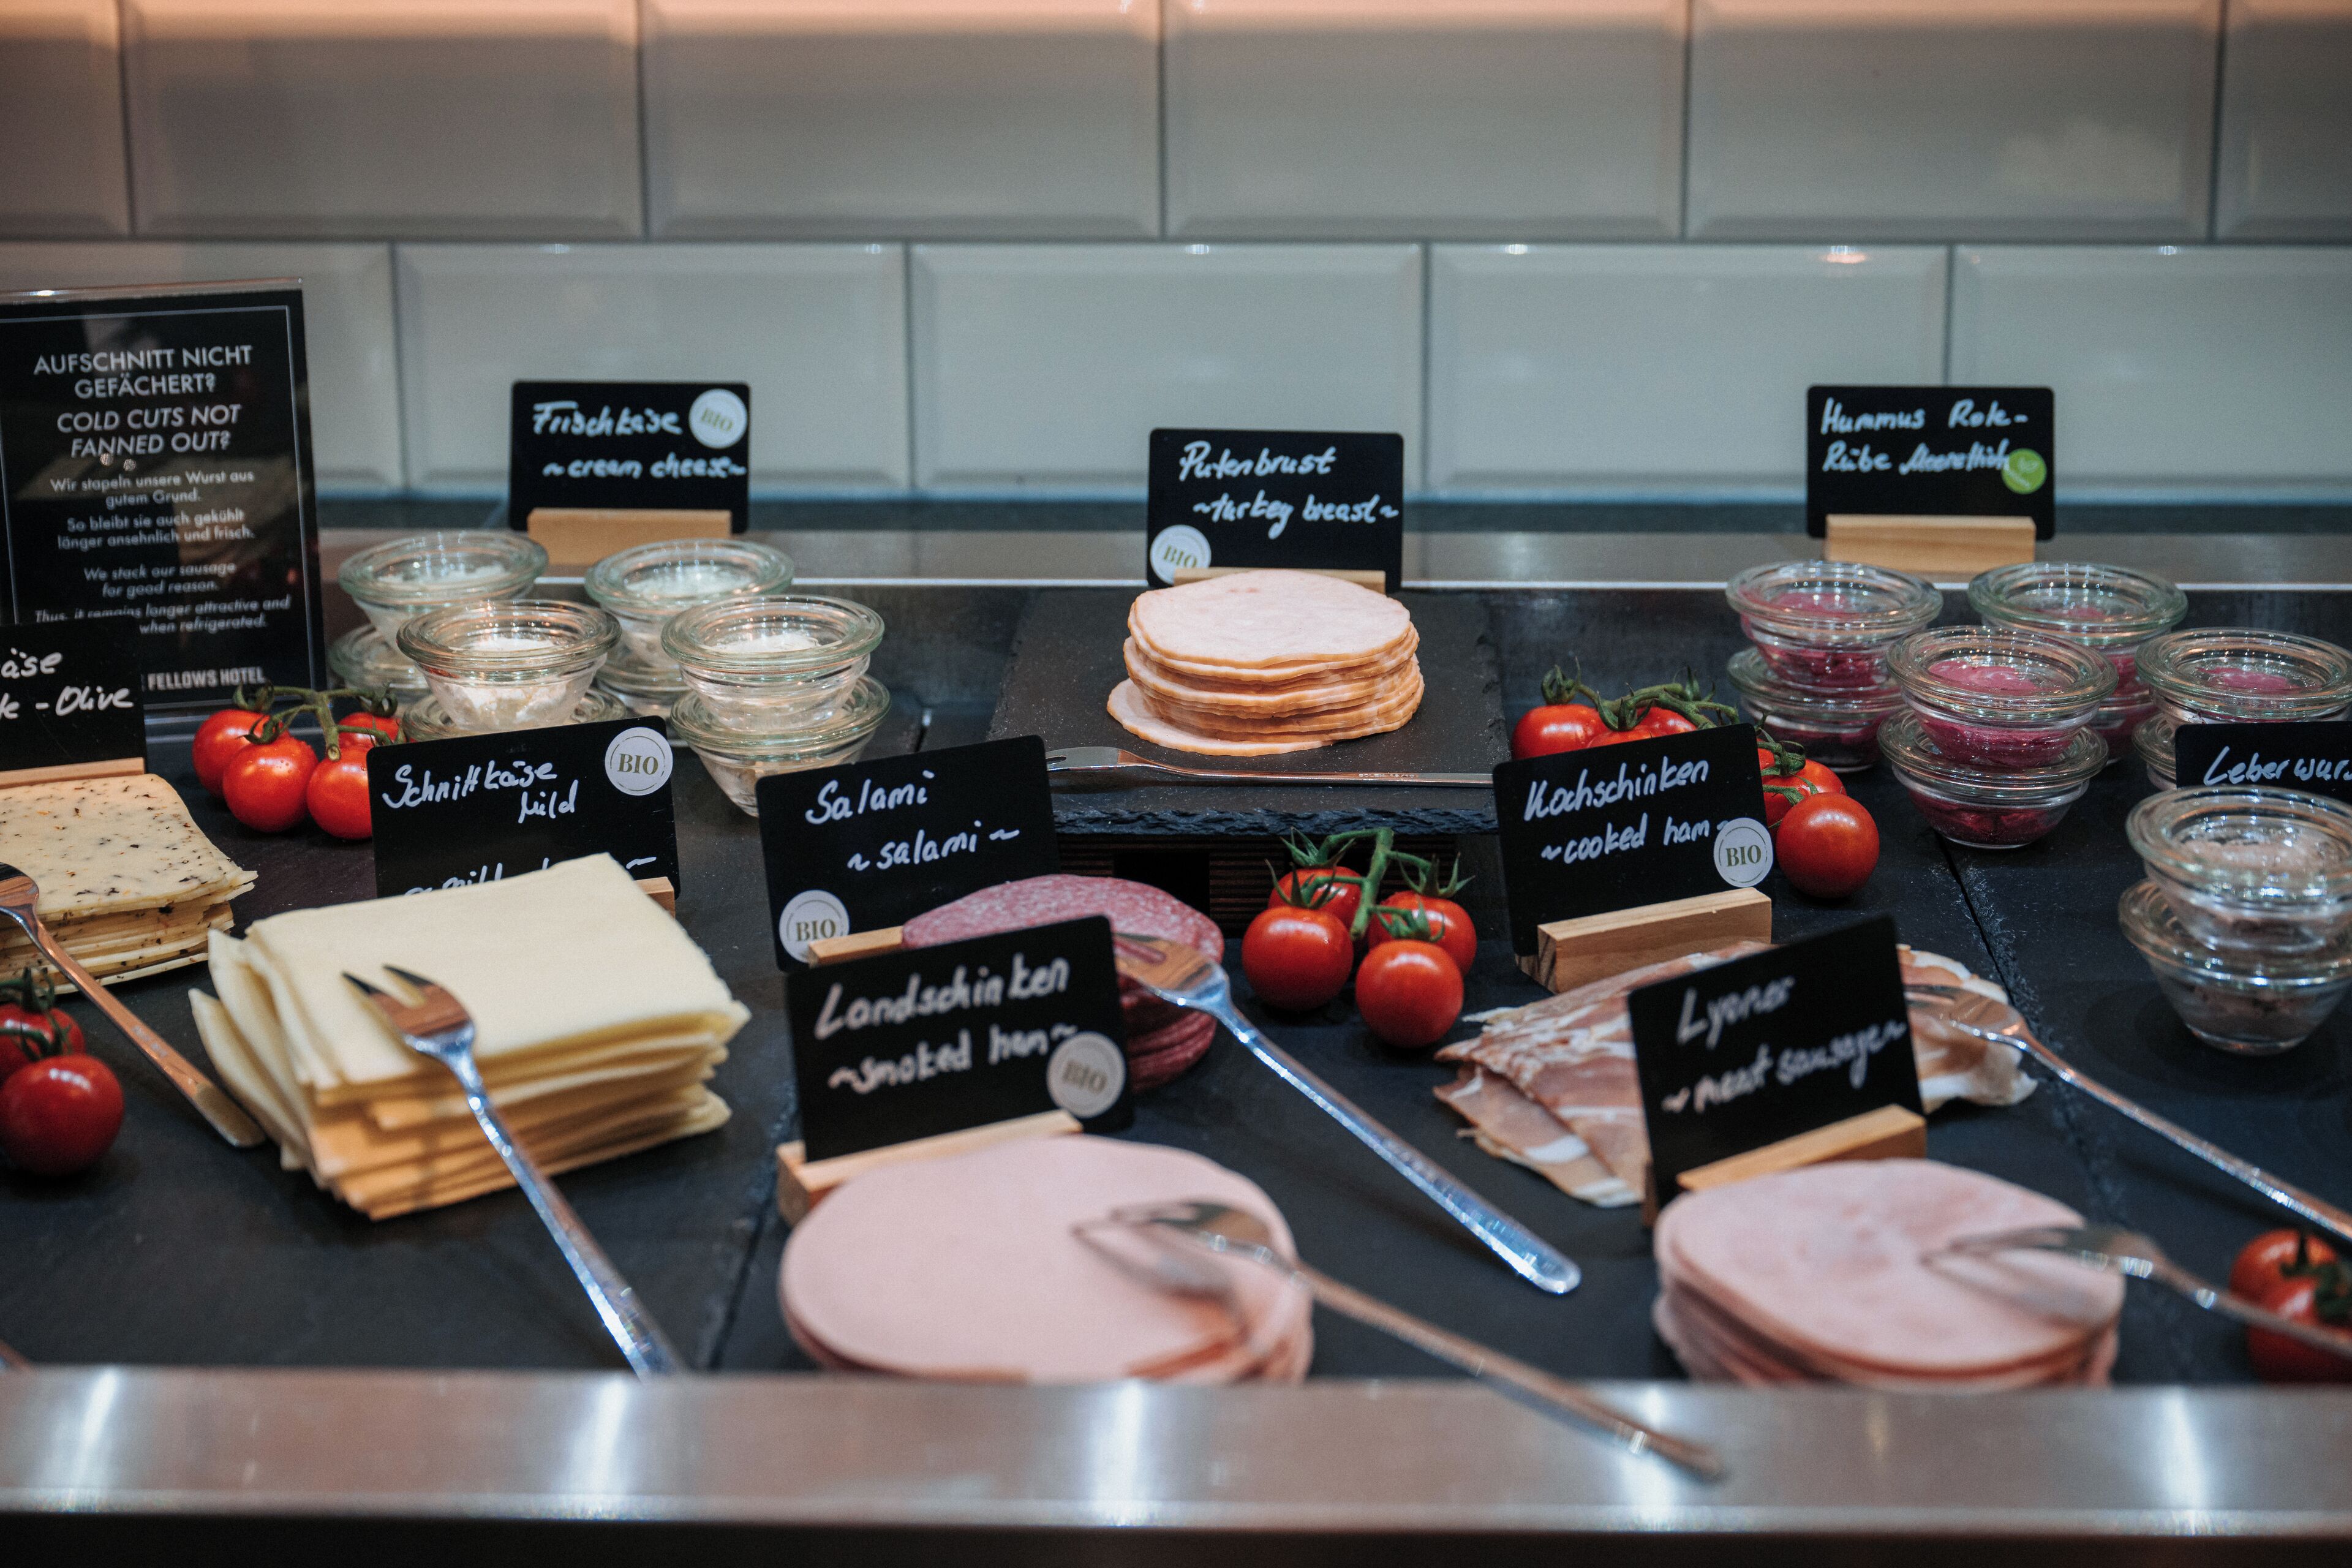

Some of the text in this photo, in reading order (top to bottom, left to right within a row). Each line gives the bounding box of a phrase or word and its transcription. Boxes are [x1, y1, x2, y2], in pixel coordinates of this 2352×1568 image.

[34, 344, 252, 375] AUFSCHNITT NICHT
[75, 373, 216, 399] GEFÄCHERT?
[57, 404, 242, 433] COLD CUTS NOT
[701, 407, 734, 432] BIO
[1821, 397, 1925, 435] Hummus
[70, 431, 231, 458] FANNED OUT?
[1822, 440, 1892, 472] Rübe
[1179, 441, 1336, 482] Putenbrust
[50, 471, 254, 492] Wir stapeln unsere Wurst aus
[105, 488, 201, 510] gutem Grund.
[67, 508, 244, 532] So bleibt sie auch gekühlt
[58, 525, 255, 551] länger ansehnlich und frisch.
[1164, 546, 1197, 567] BIO
[84, 561, 236, 581] We stack our sausage
[102, 580, 219, 599] for good reason.
[88, 605, 142, 619] remains
[146, 603, 191, 619] longer
[195, 600, 259, 614] attractive
[263, 594, 292, 609] and
[140, 613, 266, 635] when refrigerated.
[148, 671, 216, 691] FELLOWS
[220, 666, 265, 685] HOTEL
[617, 753, 658, 775] BIO
[383, 760, 557, 809] Schnittkäse
[1523, 755, 1709, 821] Kochschinken
[805, 771, 934, 824] Salami
[1725, 845, 1762, 867] BIO
[796, 918, 835, 942] BIO
[815, 953, 1069, 1039] Landschinken
[1062, 1060, 1107, 1095] BIO
